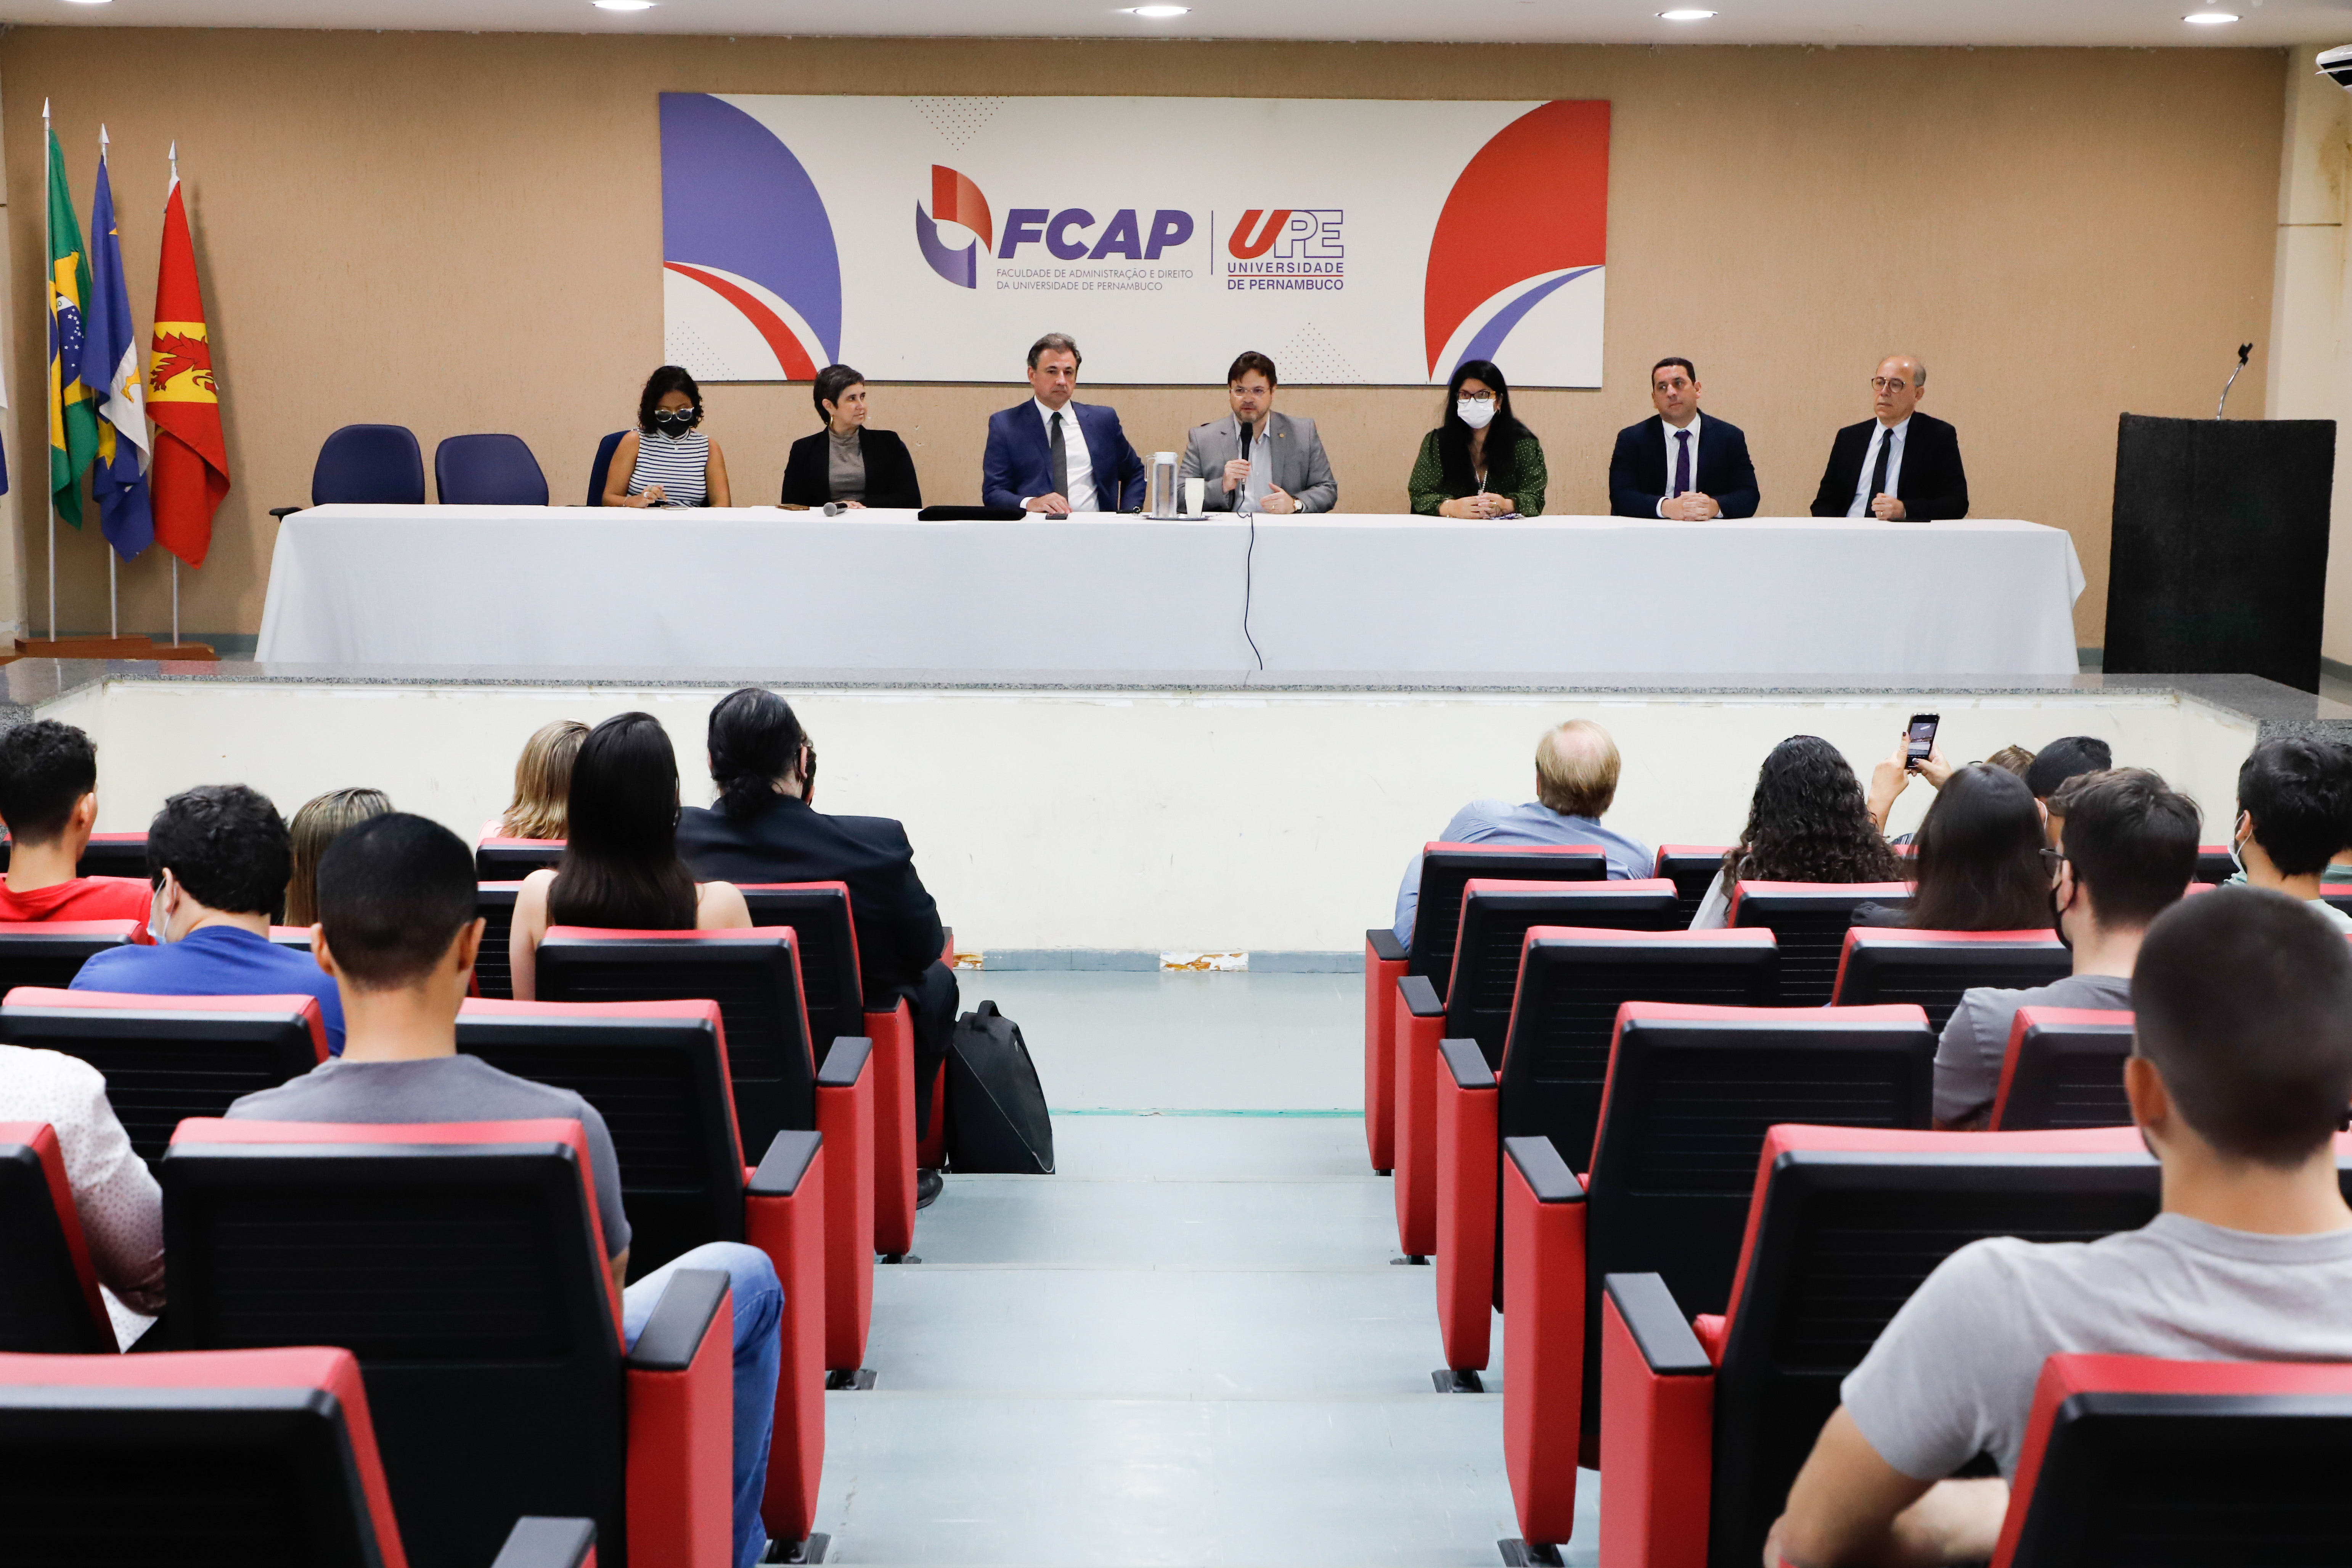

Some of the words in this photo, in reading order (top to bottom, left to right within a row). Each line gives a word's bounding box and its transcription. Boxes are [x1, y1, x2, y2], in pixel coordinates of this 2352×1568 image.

[998, 208, 1194, 260] FCAP
[1228, 209, 1344, 260] UPE
[1227, 262, 1344, 273] UNIVERSIDADE
[997, 269, 1051, 278] FACULDADE
[1054, 269, 1066, 278] DE
[1069, 268, 1147, 280] ADMINISTRAÇÃO
[1150, 270, 1154, 278] E
[1158, 270, 1193, 278] DIREITO
[997, 281, 1010, 289] DA
[1013, 281, 1079, 290] UNIVERSIDADE
[1082, 282, 1094, 290] DE
[1097, 282, 1162, 291] PERNAMBUCO
[1227, 279, 1245, 290] DE
[1250, 279, 1344, 290] PERNAMBUCO
